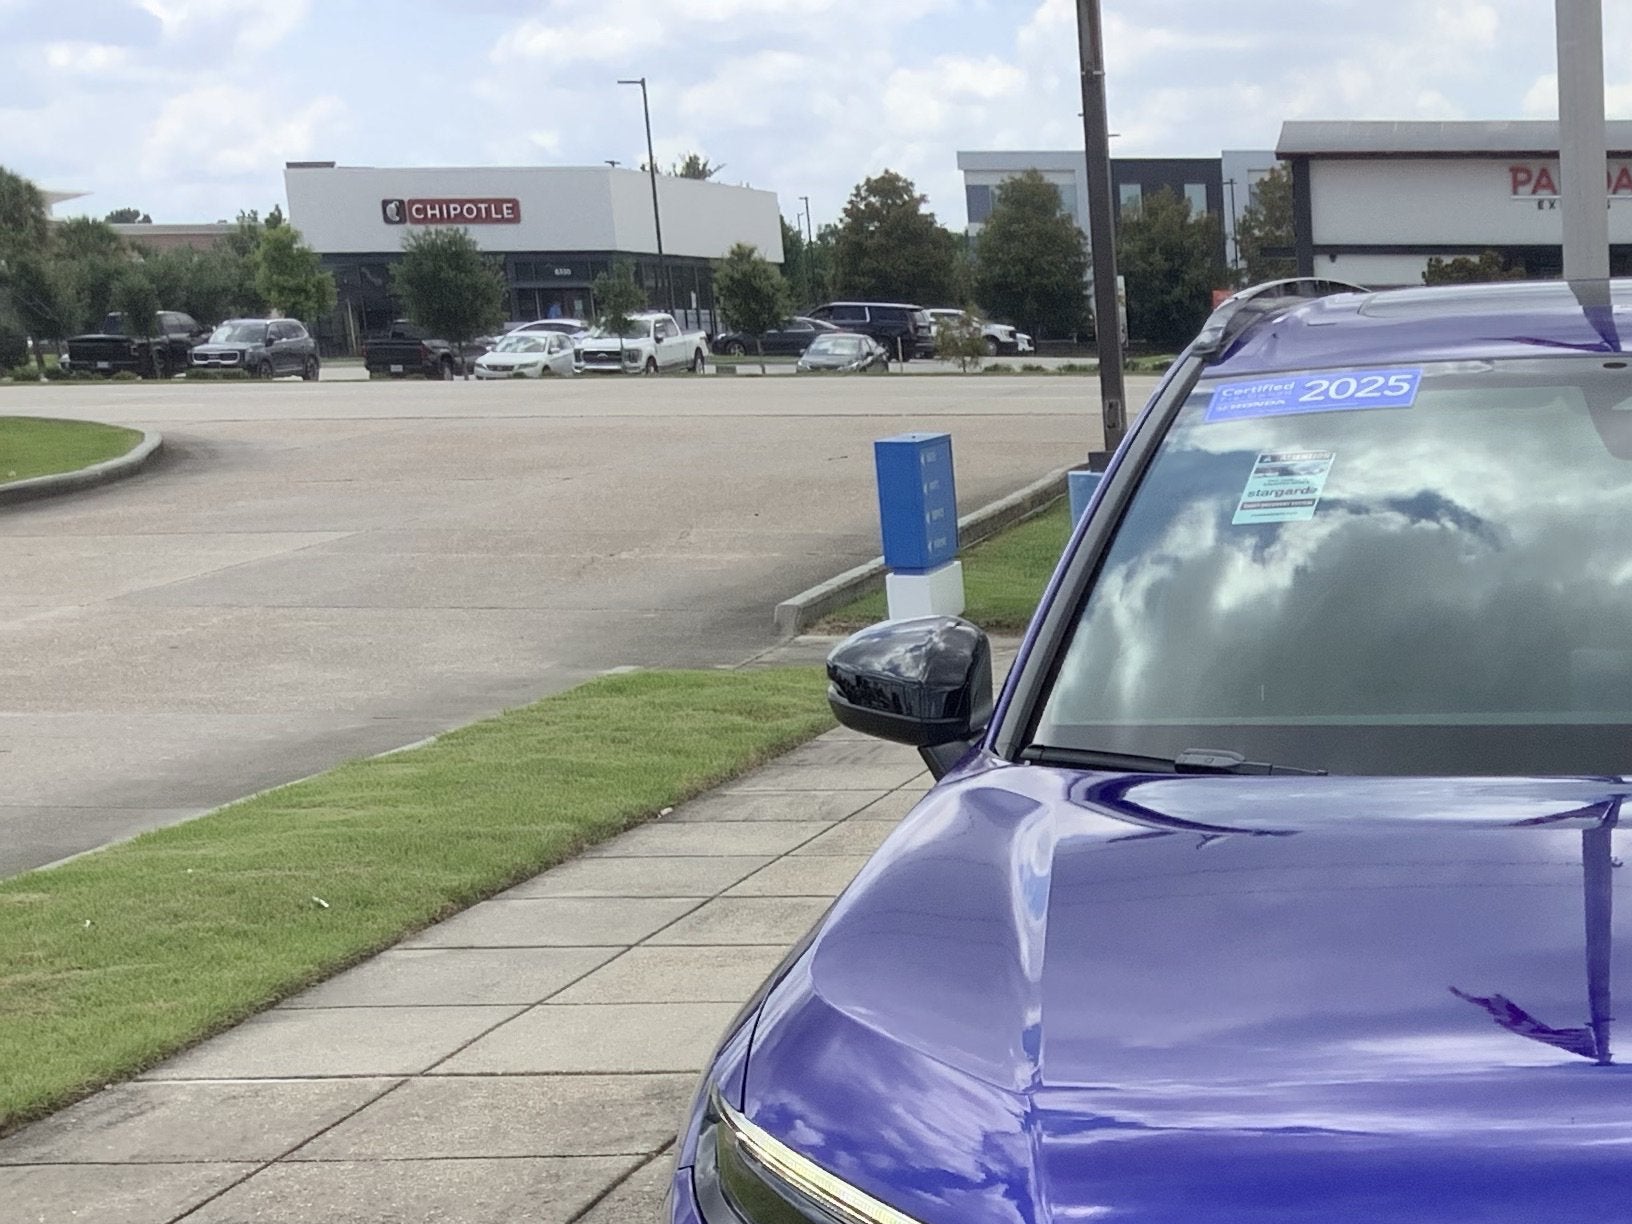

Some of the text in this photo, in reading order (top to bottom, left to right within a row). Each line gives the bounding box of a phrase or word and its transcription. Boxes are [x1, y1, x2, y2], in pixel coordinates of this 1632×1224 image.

[411, 203, 515, 219] CHIPOTLE
[1222, 381, 1295, 396] Certified
[1299, 374, 1414, 402] 2025
